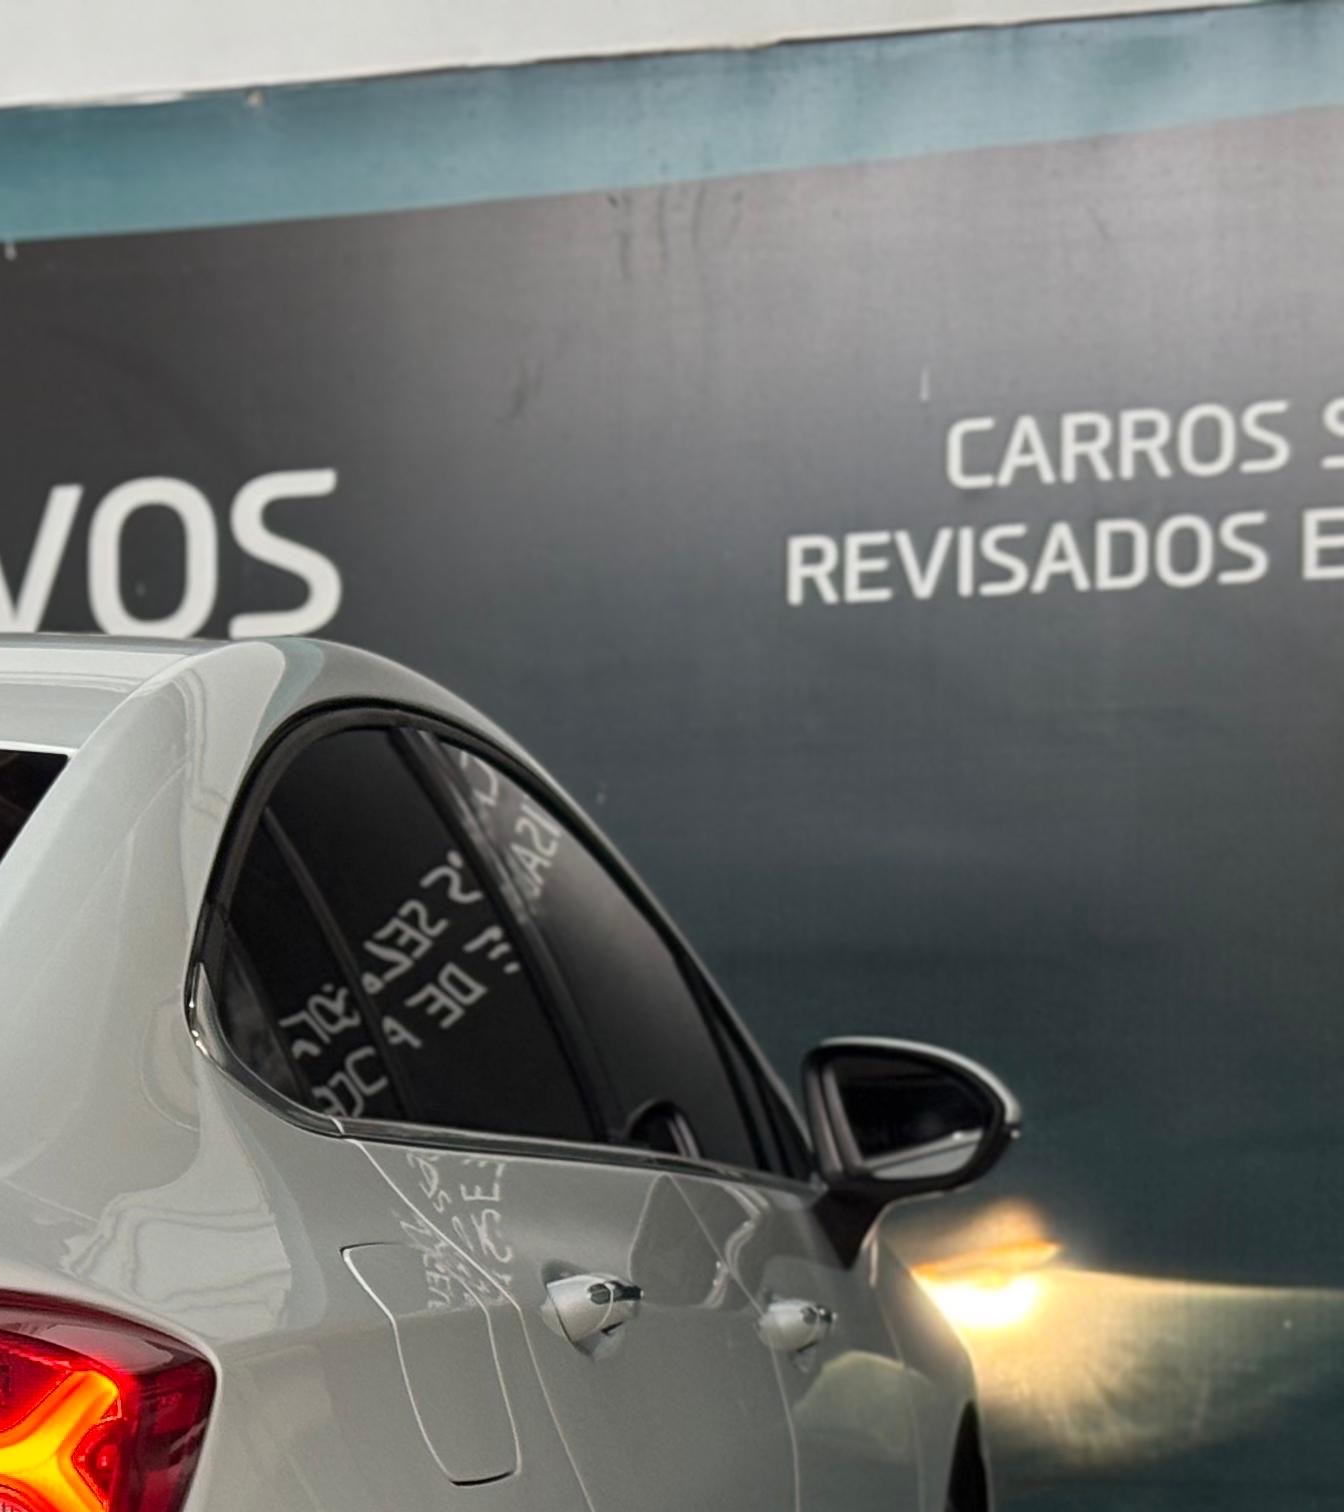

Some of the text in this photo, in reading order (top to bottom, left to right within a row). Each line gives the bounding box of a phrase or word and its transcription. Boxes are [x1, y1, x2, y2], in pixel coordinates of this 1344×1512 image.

[947, 400, 1291, 490] CARROS
[786, 508, 1344, 606] REVISADOS E
